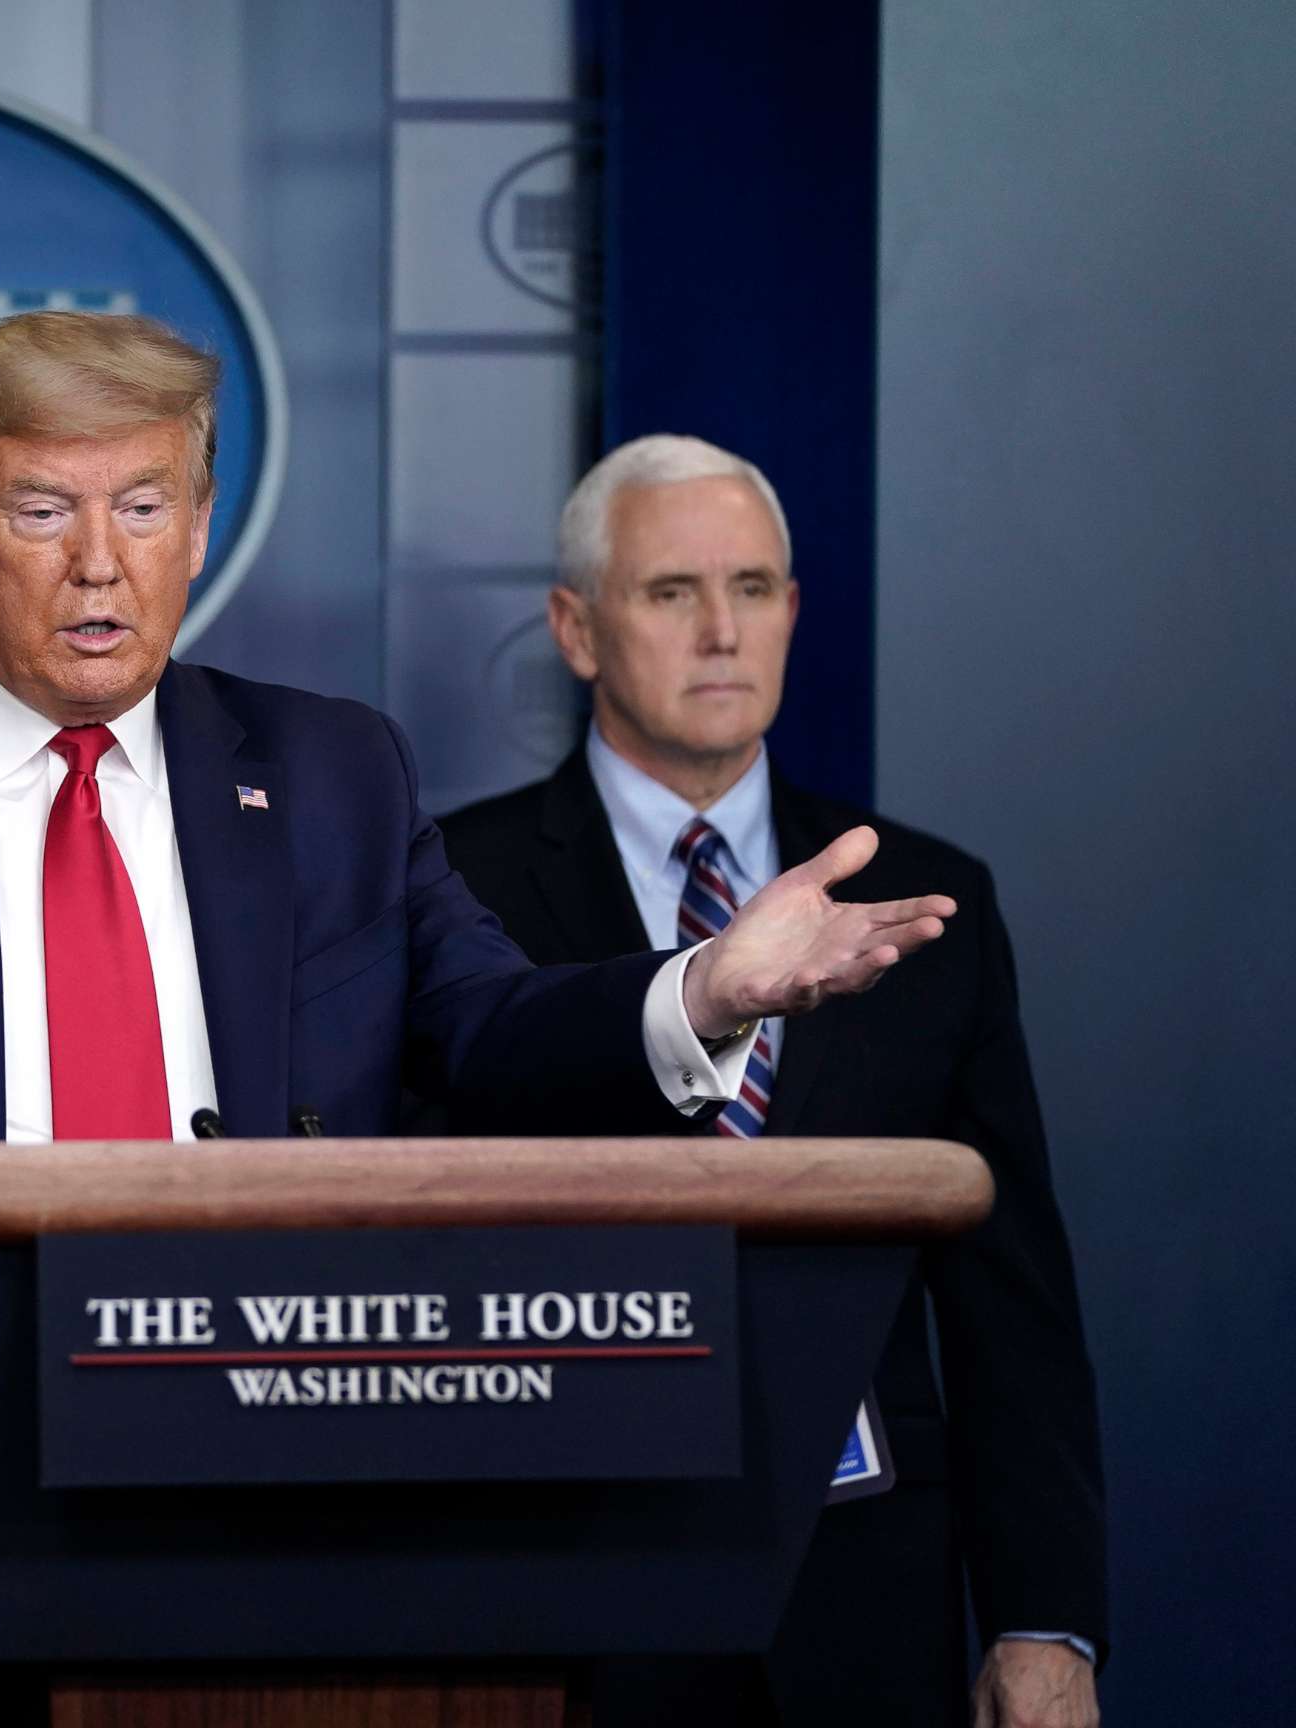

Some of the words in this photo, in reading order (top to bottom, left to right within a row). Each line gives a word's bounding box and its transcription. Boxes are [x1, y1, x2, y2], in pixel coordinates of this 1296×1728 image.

[85, 1297, 216, 1347] THE
[235, 1294, 450, 1344] WHITE
[478, 1291, 694, 1340] HOUSE
[225, 1363, 554, 1406] WASHINGTON
